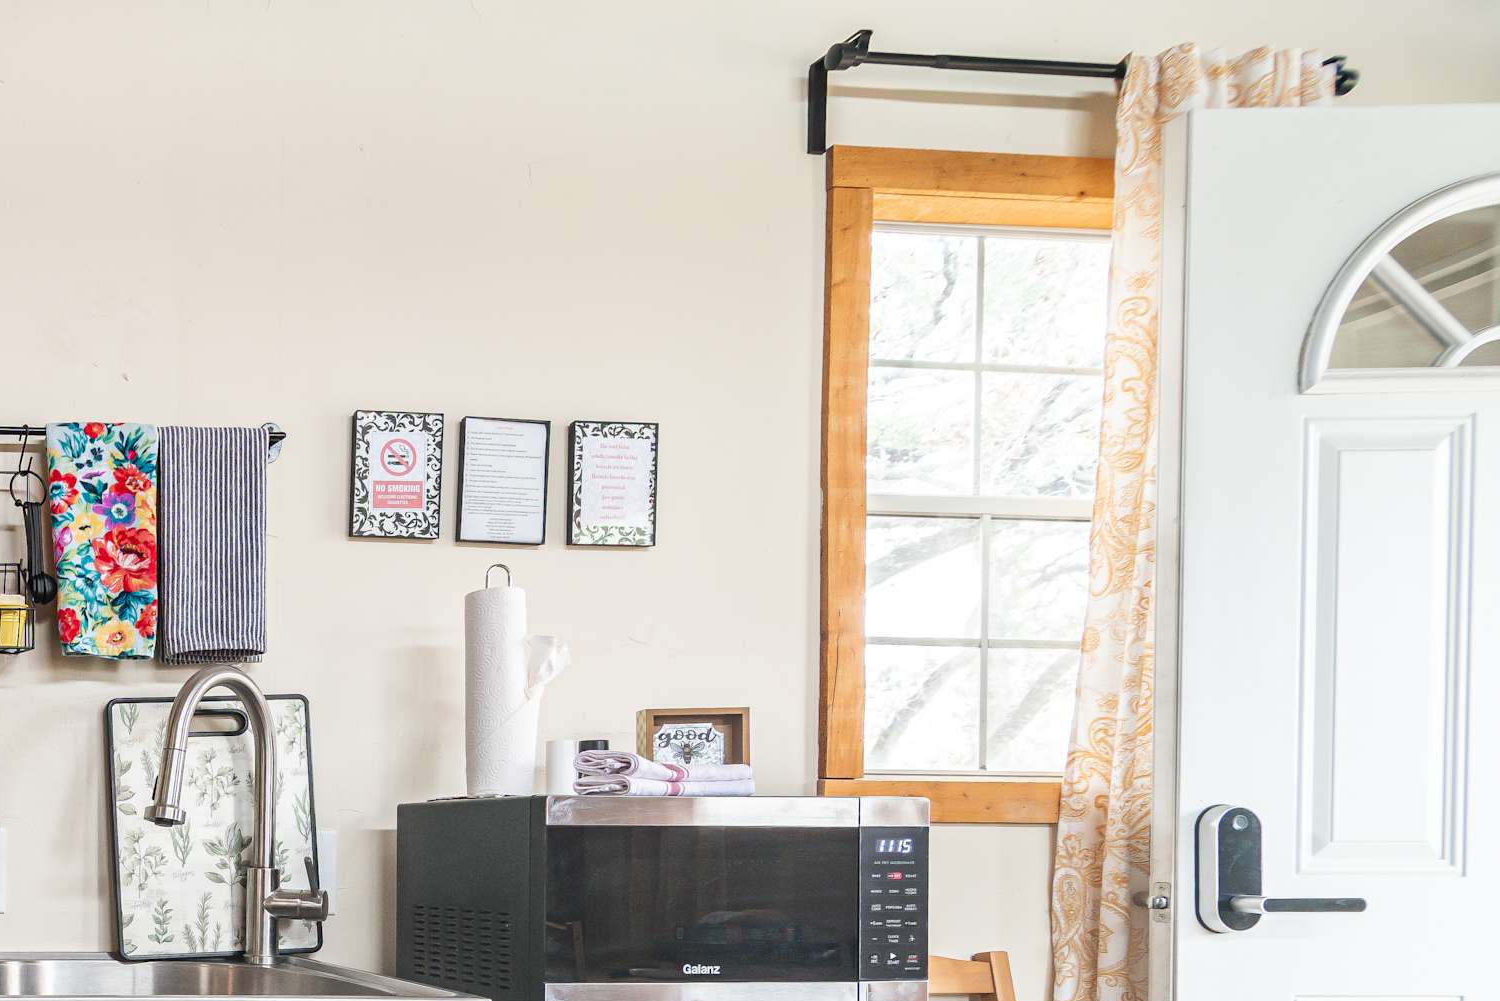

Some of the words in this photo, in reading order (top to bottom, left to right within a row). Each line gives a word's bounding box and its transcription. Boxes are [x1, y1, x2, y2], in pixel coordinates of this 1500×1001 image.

[376, 484, 385, 492] NO
[387, 484, 421, 493] SMOKING
[658, 727, 717, 748] good
[682, 963, 721, 975] Galanz
